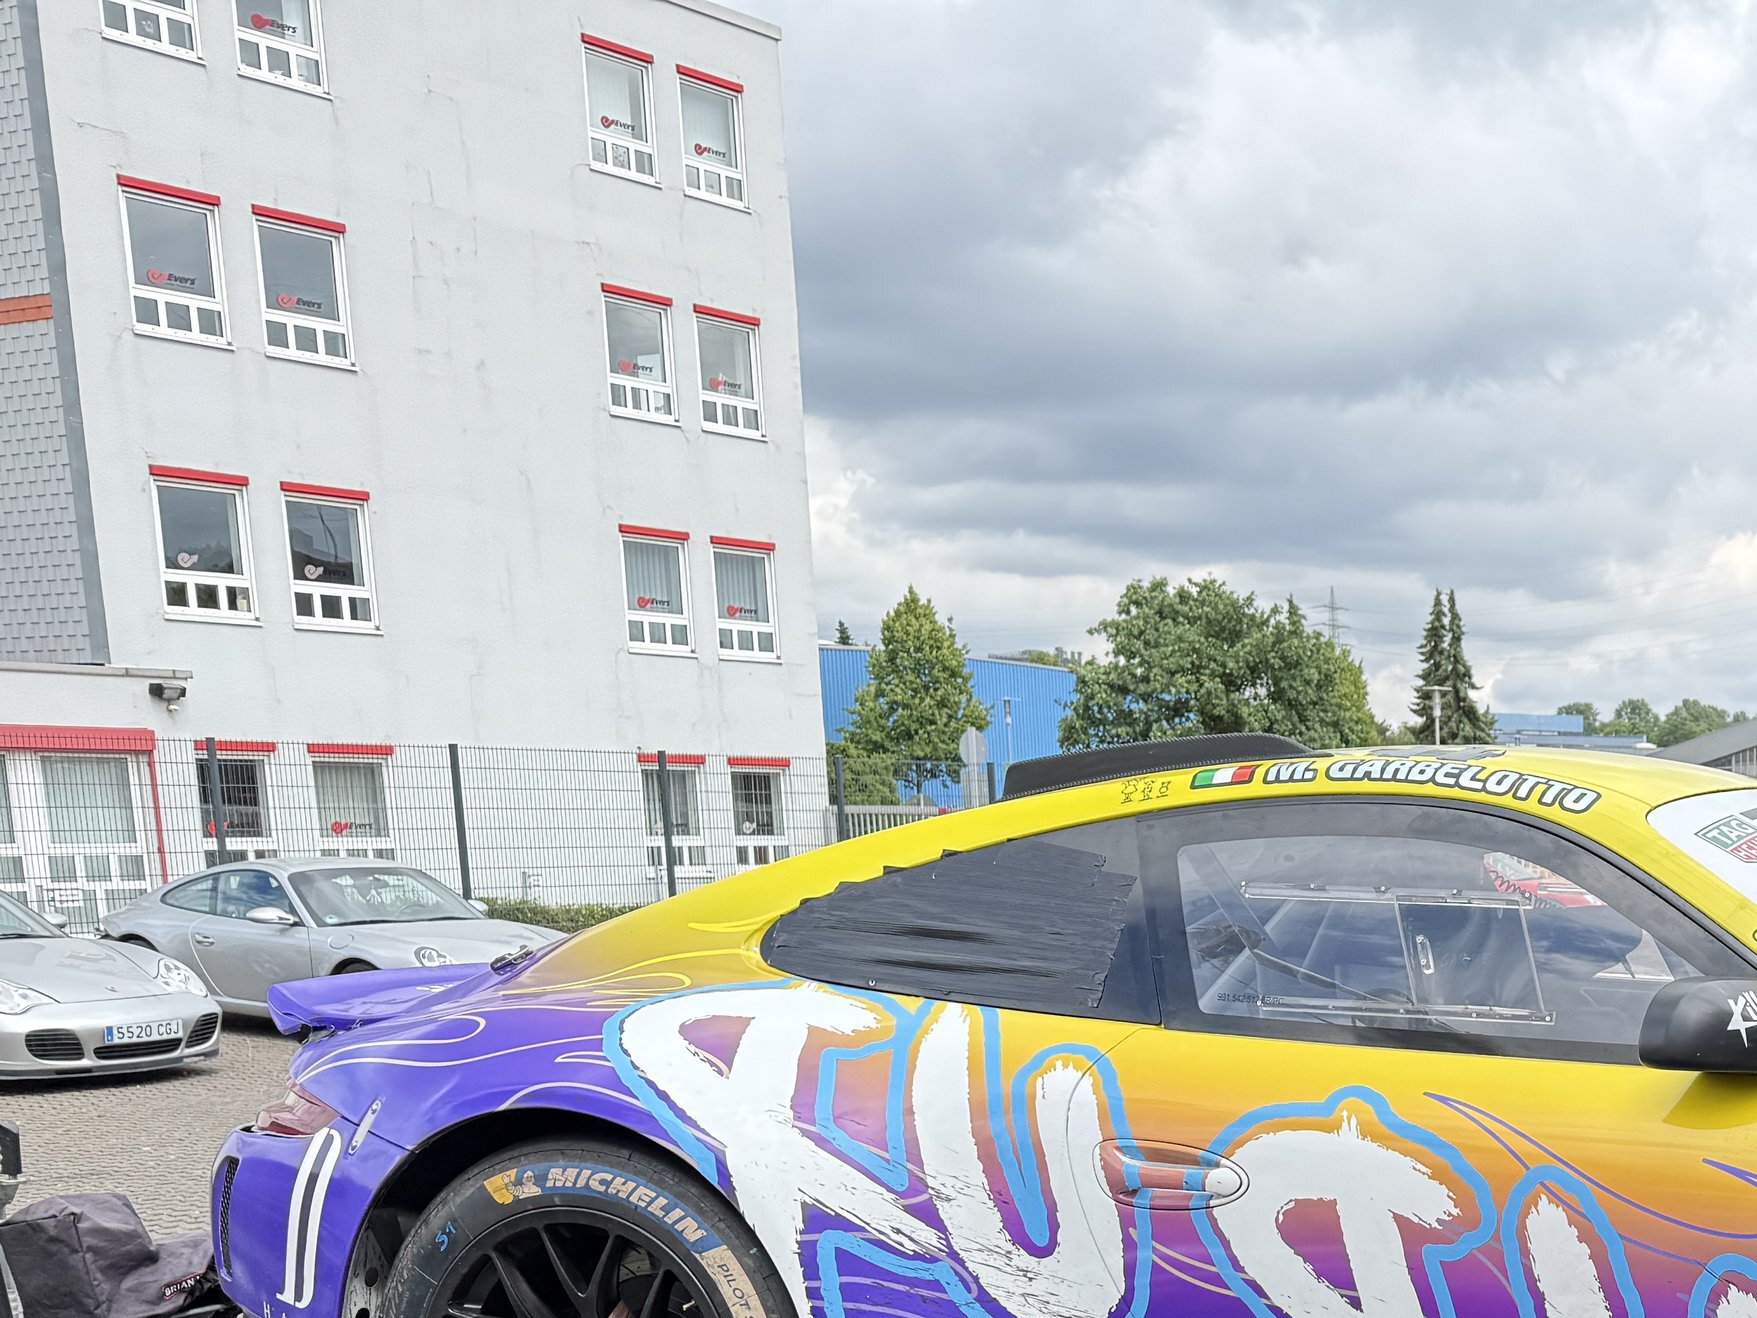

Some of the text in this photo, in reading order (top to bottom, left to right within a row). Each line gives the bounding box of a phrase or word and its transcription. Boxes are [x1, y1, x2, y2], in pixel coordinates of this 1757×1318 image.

[271, 18, 298, 34] Evers
[614, 119, 636, 132] Evers
[706, 147, 727, 159] Evers
[167, 273, 197, 286] Evers
[295, 297, 322, 310] Evers
[633, 363, 654, 373] Evers
[723, 380, 742, 390] Evers
[650, 598, 671, 607] Evers
[738, 606, 758, 616] Evers
[1264, 759, 1602, 814] M. GARBELOTTO
[1707, 819, 1754, 846] TAG
[116, 1021, 180, 1040] 5520 CGJ
[545, 1167, 709, 1244] MICHELIN
[164, 1278, 195, 1298] BRIAN
[717, 1262, 752, 1311] PILOT
